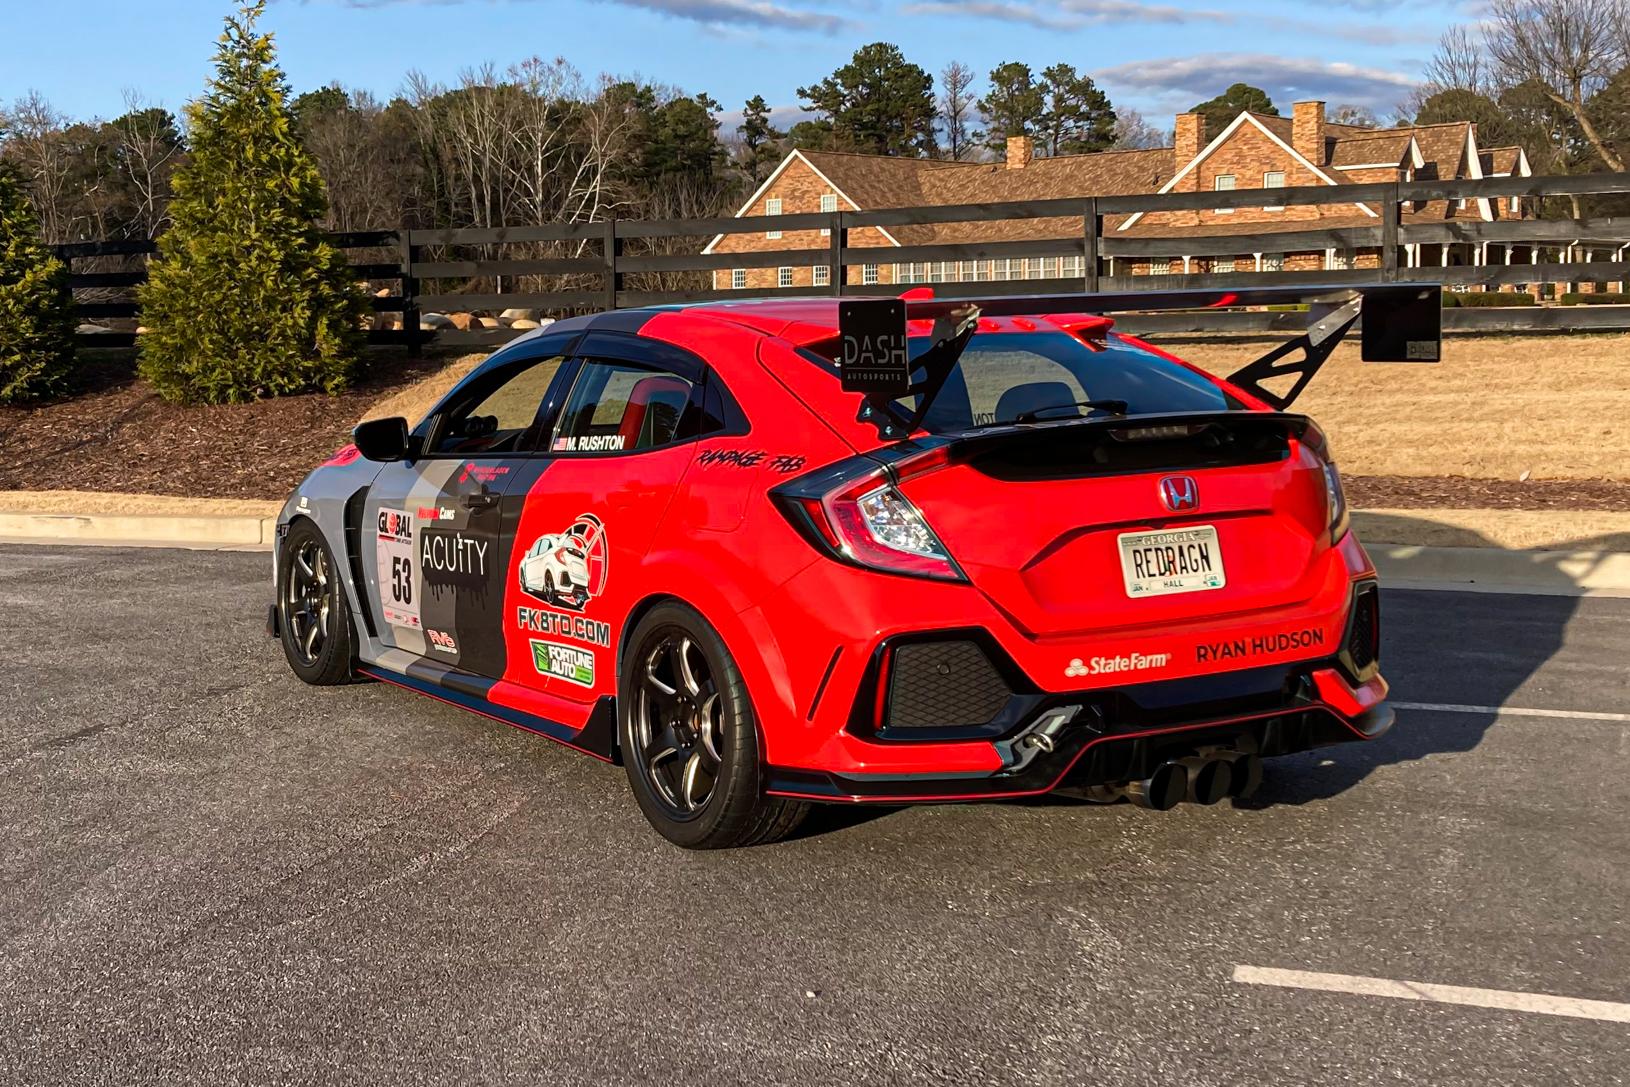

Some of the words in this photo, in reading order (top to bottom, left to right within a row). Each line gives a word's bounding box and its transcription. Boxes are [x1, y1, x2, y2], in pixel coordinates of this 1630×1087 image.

[844, 335, 905, 364] DASH
[847, 373, 901, 381] AUTOSPORTS
[566, 437, 578, 450] M.
[579, 435, 626, 450] RUSHTON
[378, 511, 412, 538] GLOBAL
[1142, 532, 1196, 545] GEORGIA
[1132, 542, 1212, 579] REDRAGN
[392, 556, 412, 605] 53
[1163, 580, 1184, 588] HALL
[1196, 640, 1246, 663] RYAN
[1252, 628, 1324, 655] HUDSON
[548, 646, 593, 669] FORTUNE
[551, 660, 576, 678] AUTO
